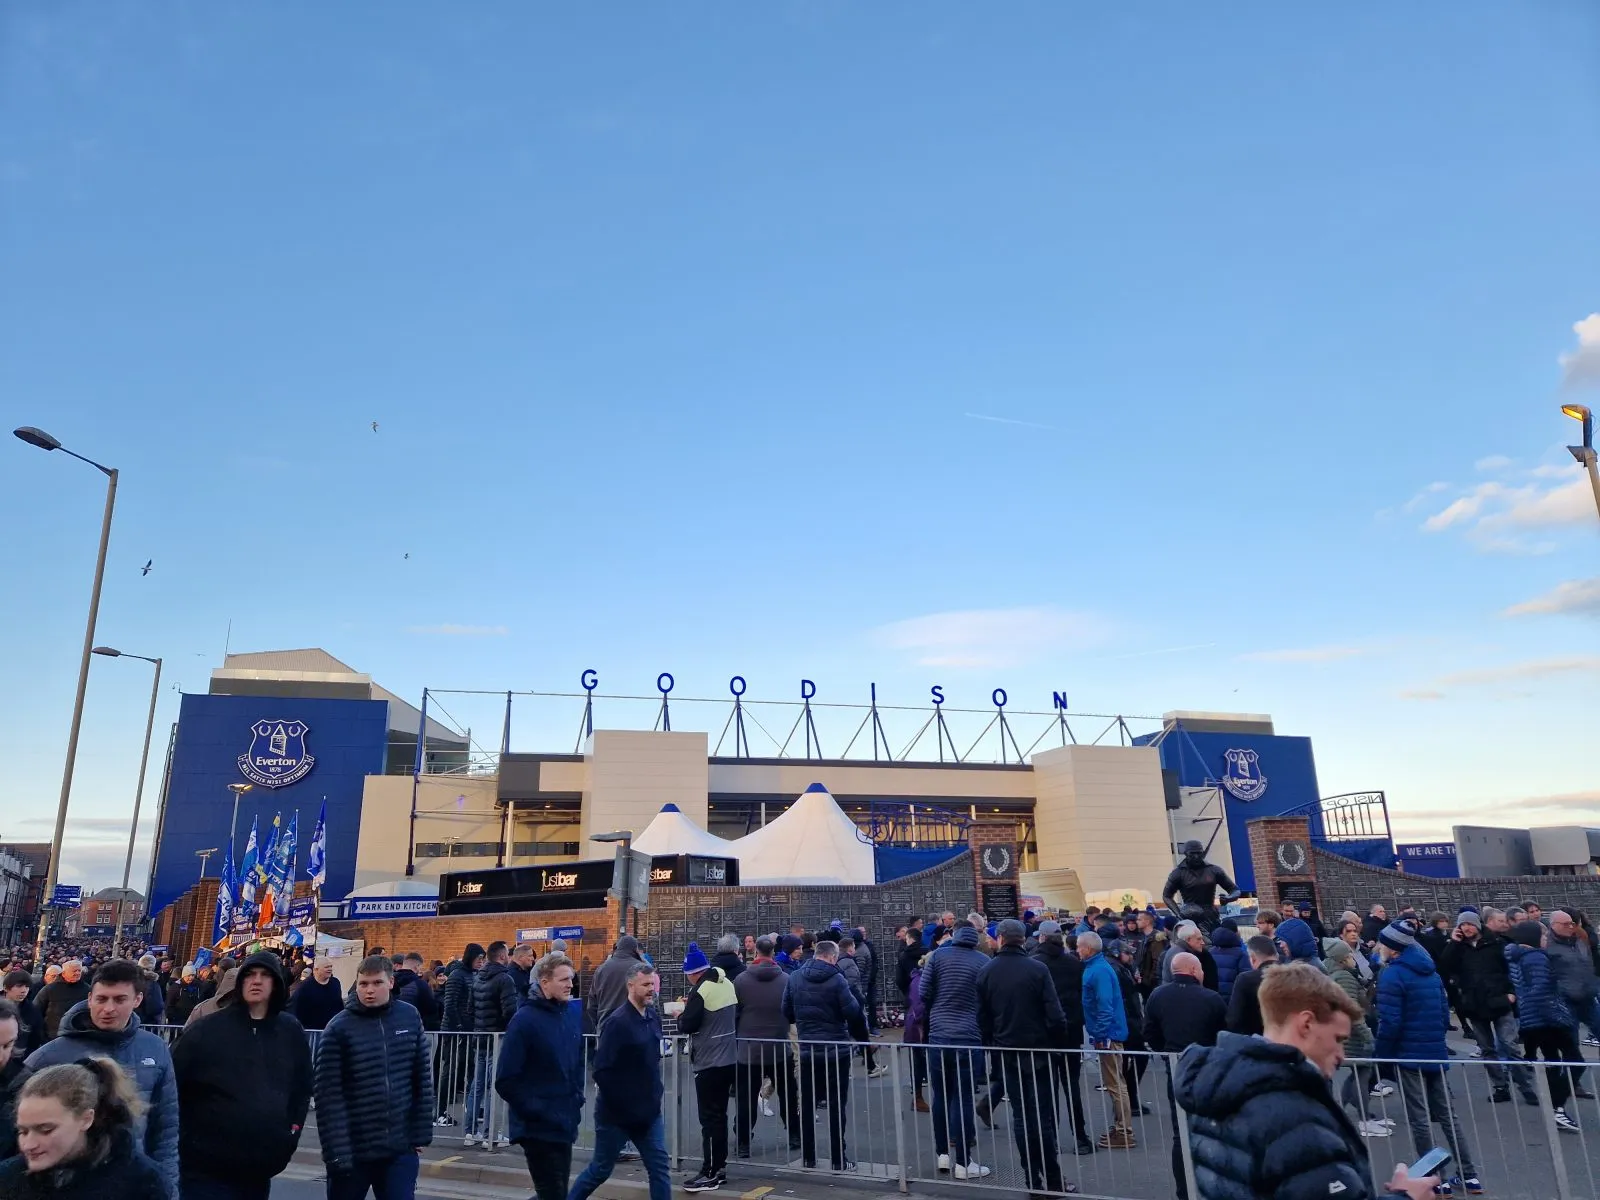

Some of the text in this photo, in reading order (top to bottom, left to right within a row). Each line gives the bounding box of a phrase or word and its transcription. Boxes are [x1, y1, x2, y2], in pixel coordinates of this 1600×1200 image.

[581, 669, 1068, 710] GOODISON
[255, 756, 296, 766] Everton
[241, 763, 249, 774] NIL
[249, 772, 266, 783] SATIS
[283, 764, 309, 783] OPTIMUM
[1406, 847, 1422, 856] WE
[1424, 846, 1444, 856] ARE
[649, 868, 673, 881] stbar
[360, 901, 437, 911] PARK END KITCHEN
